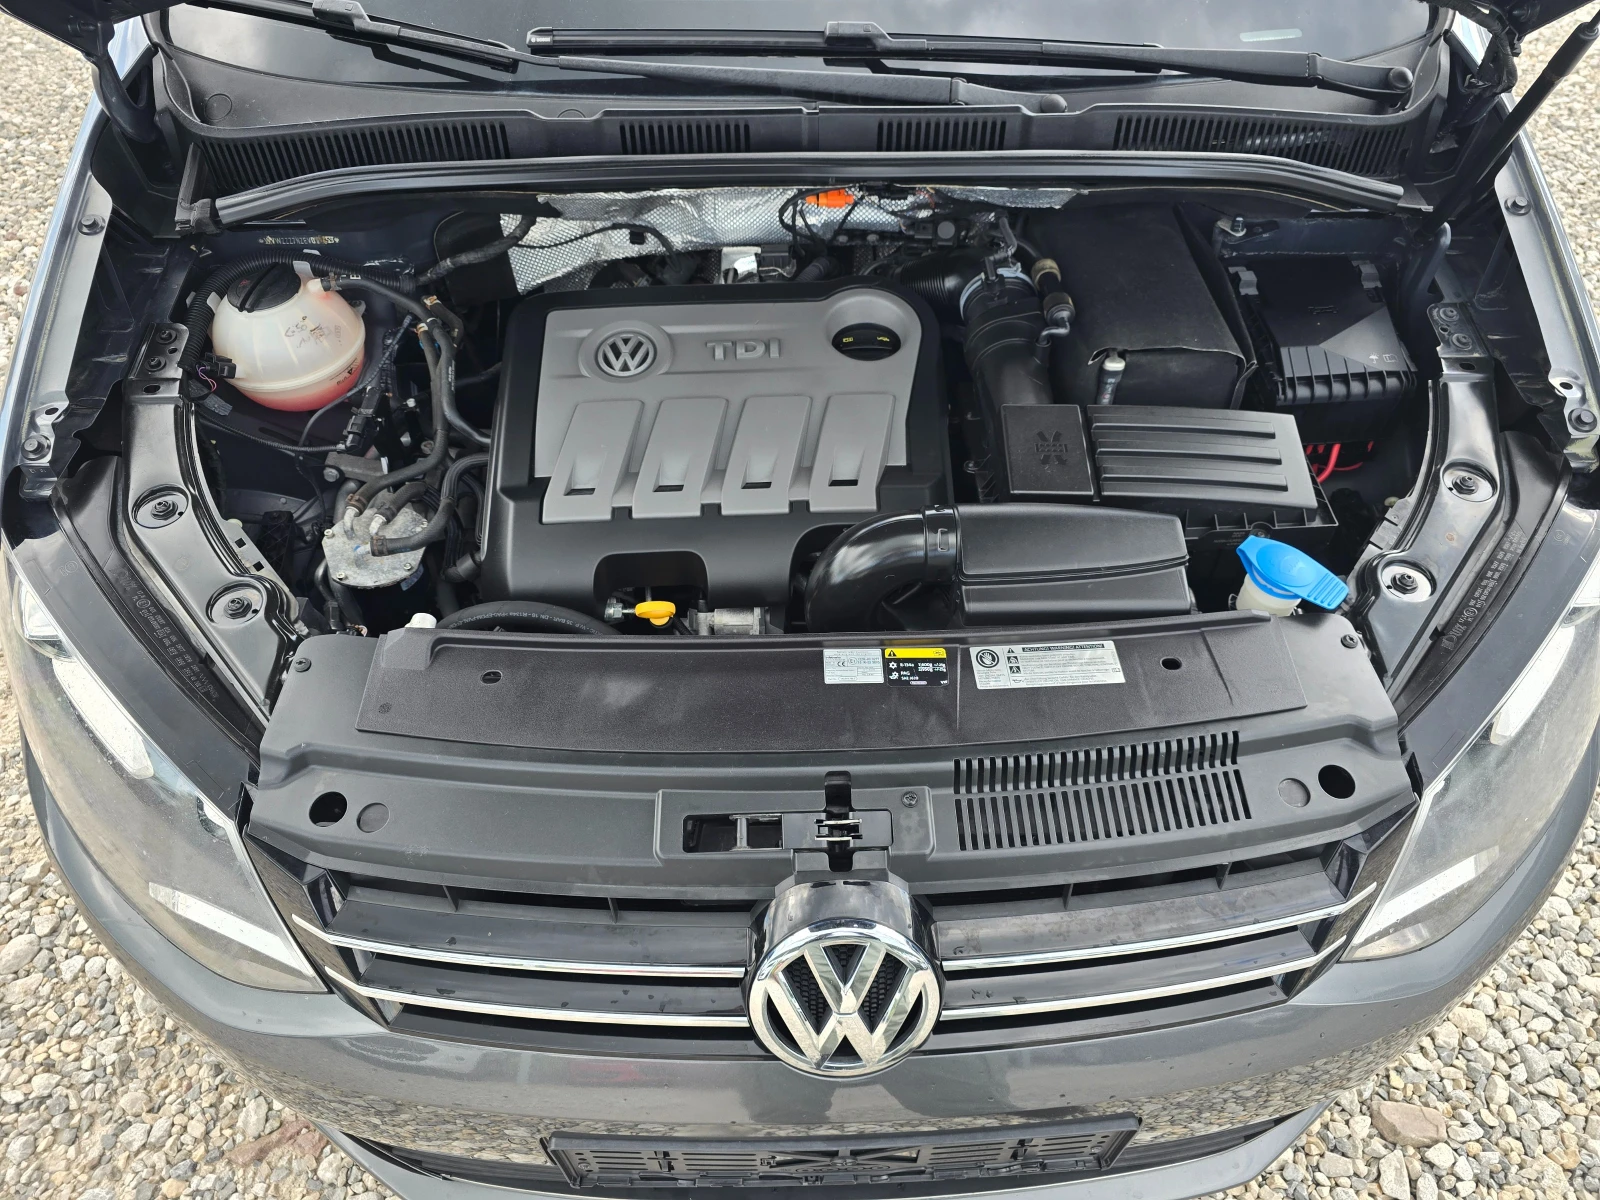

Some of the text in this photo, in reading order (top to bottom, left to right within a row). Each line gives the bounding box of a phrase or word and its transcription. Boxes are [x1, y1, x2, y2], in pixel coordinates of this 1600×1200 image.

[599, 333, 654, 375] VW
[706, 338, 781, 361] TDI
[760, 938, 930, 1072] VW
